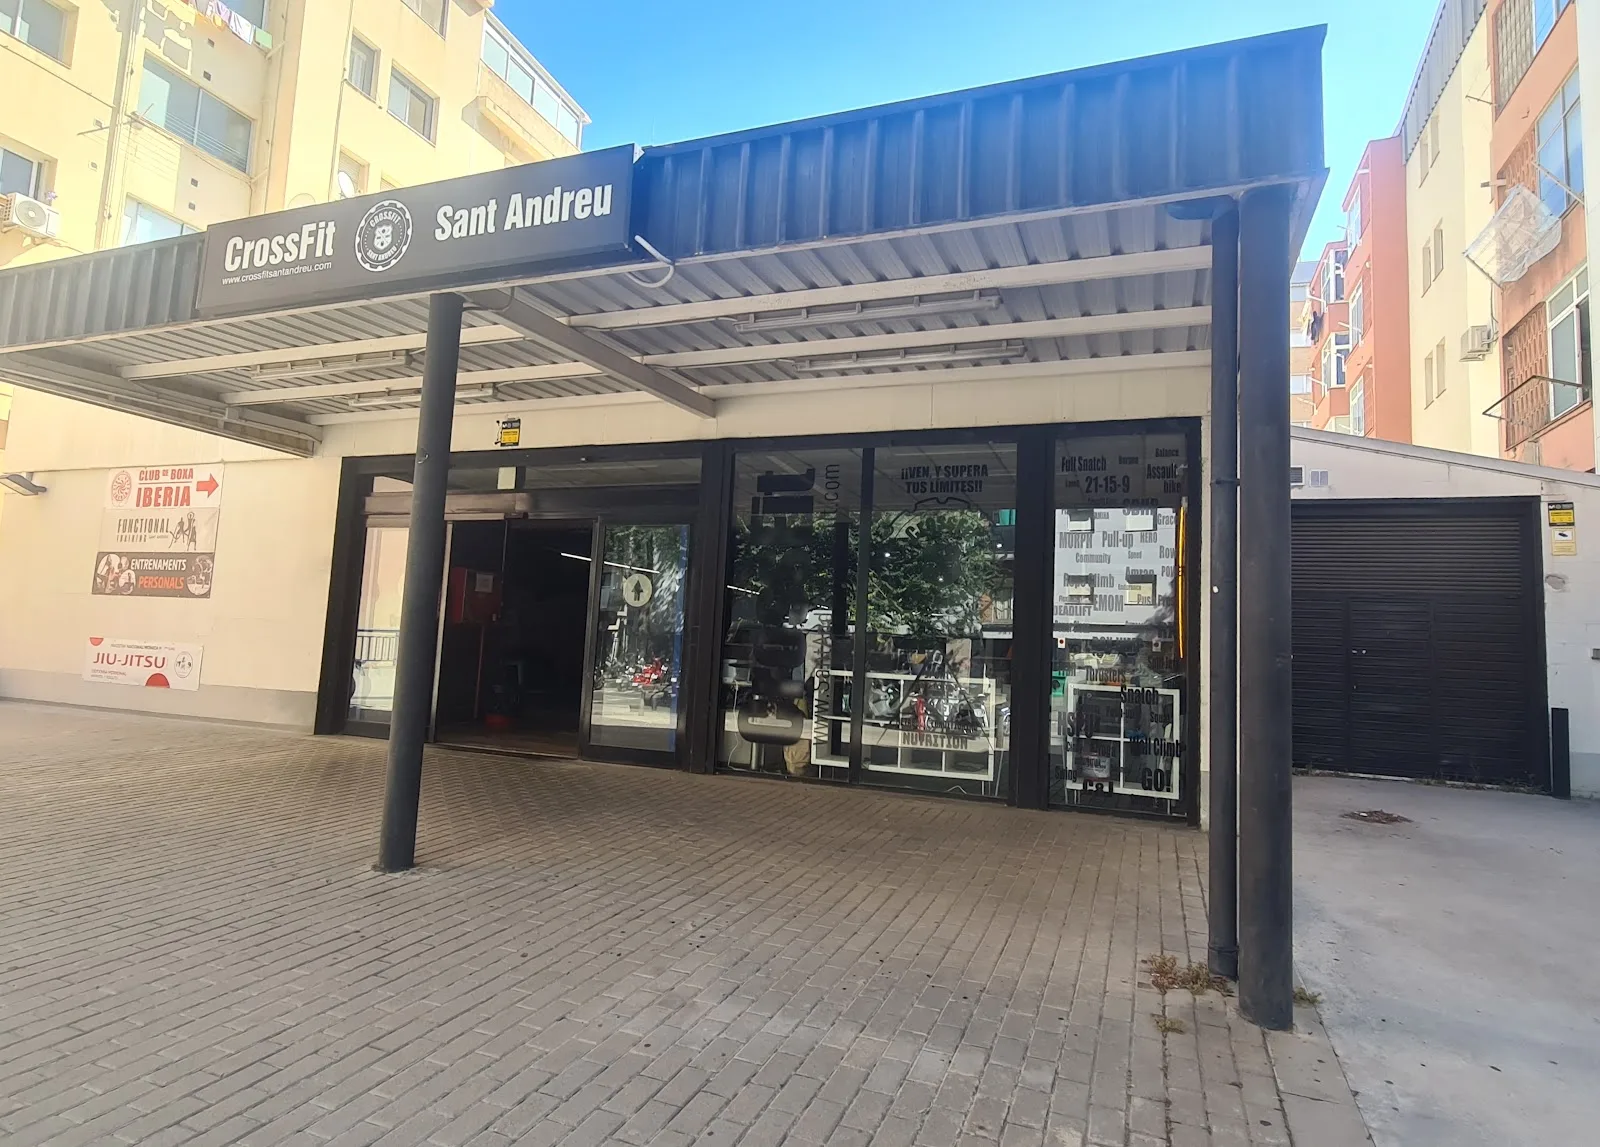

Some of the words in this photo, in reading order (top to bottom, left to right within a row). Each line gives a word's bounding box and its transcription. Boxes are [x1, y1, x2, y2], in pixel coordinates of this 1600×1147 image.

[369, 211, 401, 227] CROSSFIT
[434, 199, 498, 241] Sant
[503, 184, 612, 231] Andreu
[224, 221, 336, 272] CrossFit
[222, 262, 332, 285] www.crossfitsantandreu.com
[935, 465, 942, 477] Y
[943, 464, 989, 477] SUPERA
[1061, 456, 1077, 472] Full
[1077, 454, 1107, 472] Snatch
[1146, 463, 1177, 480] Assault
[139, 469, 160, 481] CLUB
[170, 468, 194, 480] BOXA
[905, 481, 928, 494] TUS
[1084, 475, 1131, 494] 21-15-9
[1163, 480, 1182, 494] bike
[135, 486, 191, 507] IBERIA
[117, 518, 170, 533] FUNCTIONAL
[1101, 531, 1134, 549] Pull-up
[1140, 532, 1158, 544] HERO
[130, 559, 187, 571] ENTRENAMENTS
[1075, 552, 1112, 565] Community
[138, 576, 185, 590] PERSONALS
[1093, 594, 1124, 612] EMOM
[93, 652, 166, 669] JIU-JITSU
[1120, 684, 1160, 705] Snatch
[1141, 767, 1171, 792] GO!
